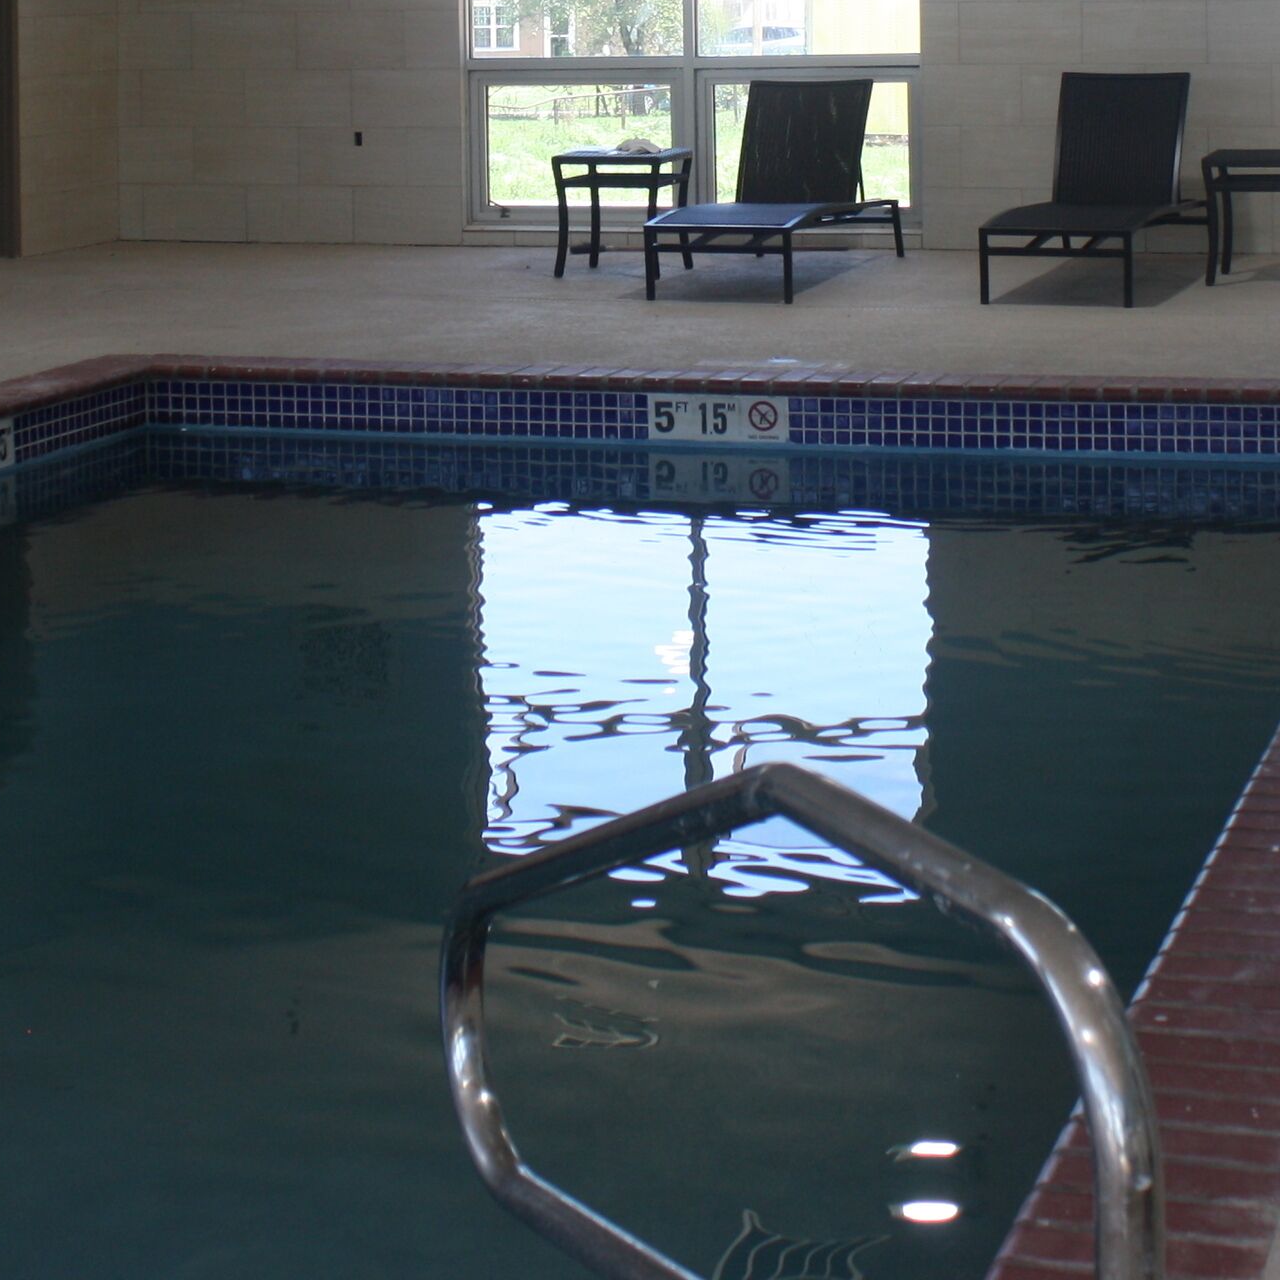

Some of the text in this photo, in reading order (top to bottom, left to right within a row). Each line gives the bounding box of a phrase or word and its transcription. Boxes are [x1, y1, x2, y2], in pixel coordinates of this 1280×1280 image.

[654, 401, 736, 435] 5 FT 1.5 M
